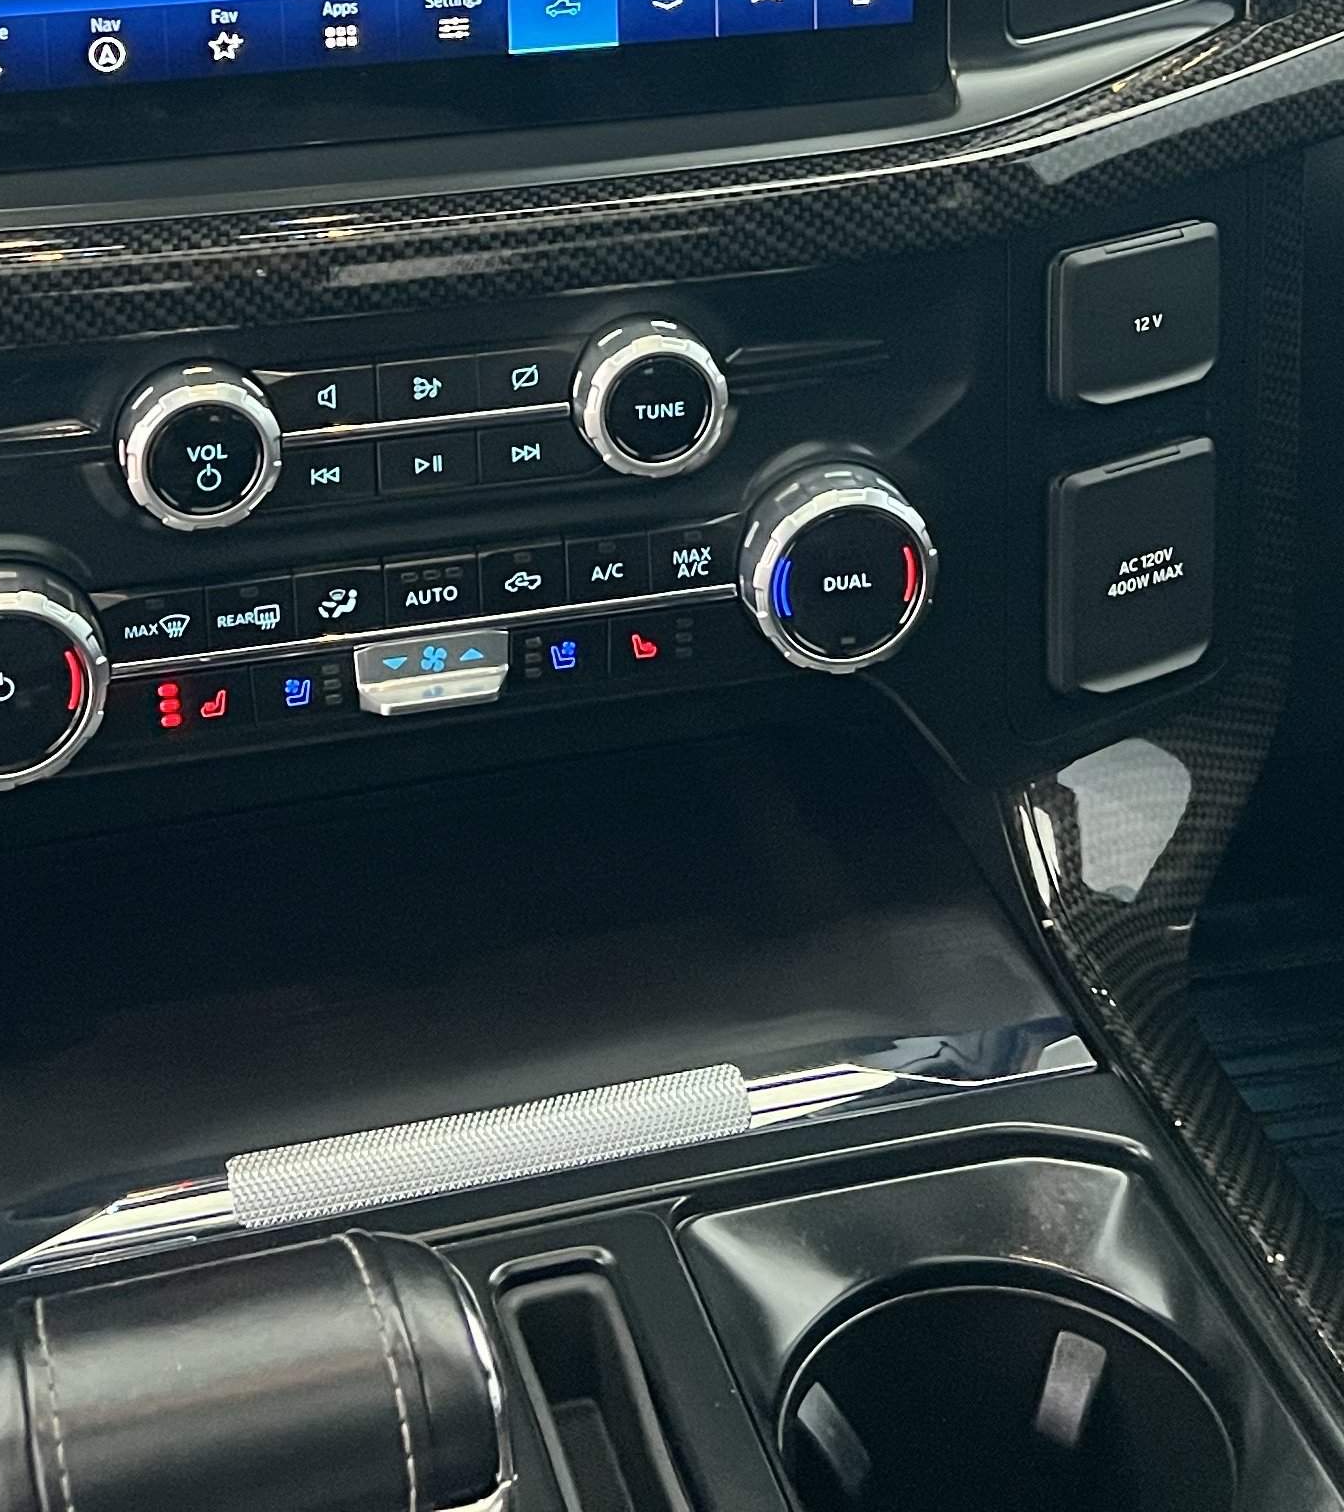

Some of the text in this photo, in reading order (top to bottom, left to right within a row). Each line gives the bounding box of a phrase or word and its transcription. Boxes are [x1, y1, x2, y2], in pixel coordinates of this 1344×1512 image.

[210, 8, 239, 25] Fav
[322, 0, 358, 18] Apps
[90, 17, 122, 34] Nav
[1134, 313, 1163, 333] 12 V
[635, 401, 686, 420] TUNE
[186, 443, 228, 462] VOL
[673, 547, 712, 566] MAX
[1119, 547, 1174, 576] AC 120V
[591, 562, 624, 582] A/C
[677, 560, 710, 579] A/C
[823, 573, 872, 592] DUAL
[1107, 562, 1184, 598] 400W MAX
[405, 585, 458, 607] AUTO
[216, 610, 255, 630] REAR
[124, 622, 159, 640] MAX
